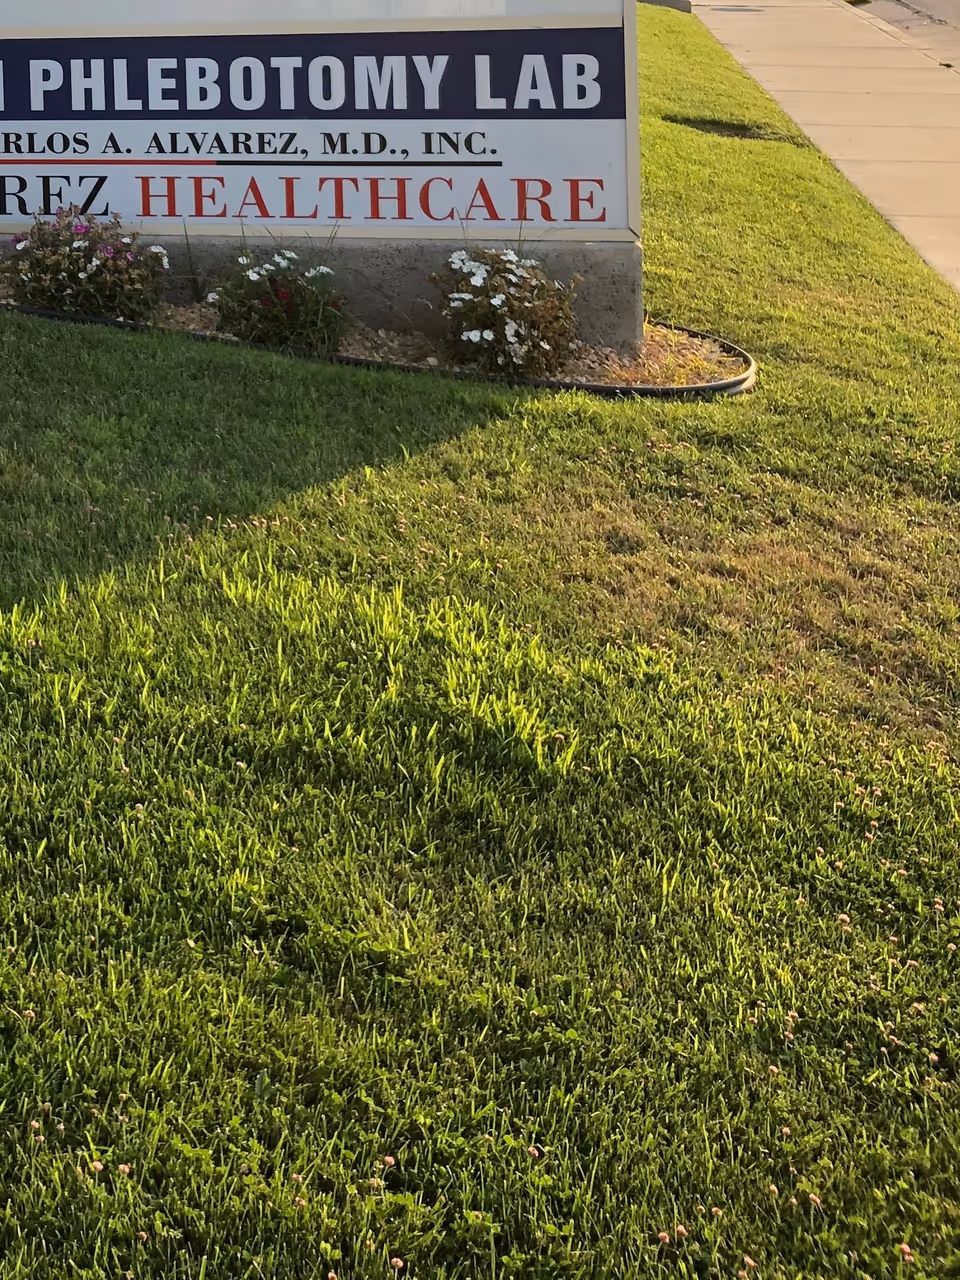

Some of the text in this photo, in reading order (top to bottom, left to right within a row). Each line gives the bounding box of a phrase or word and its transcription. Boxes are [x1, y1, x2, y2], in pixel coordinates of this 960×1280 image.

[28, 54, 449, 112] PHLEBOTOMY
[474, 53, 602, 110] LAB
[100, 131, 133, 155] A.
[143, 131, 309, 160] ALVAREZ,
[321, 131, 410, 160] M.D.,
[421, 131, 498, 156] INC.
[134, 175, 607, 223] HEALTHCARE
